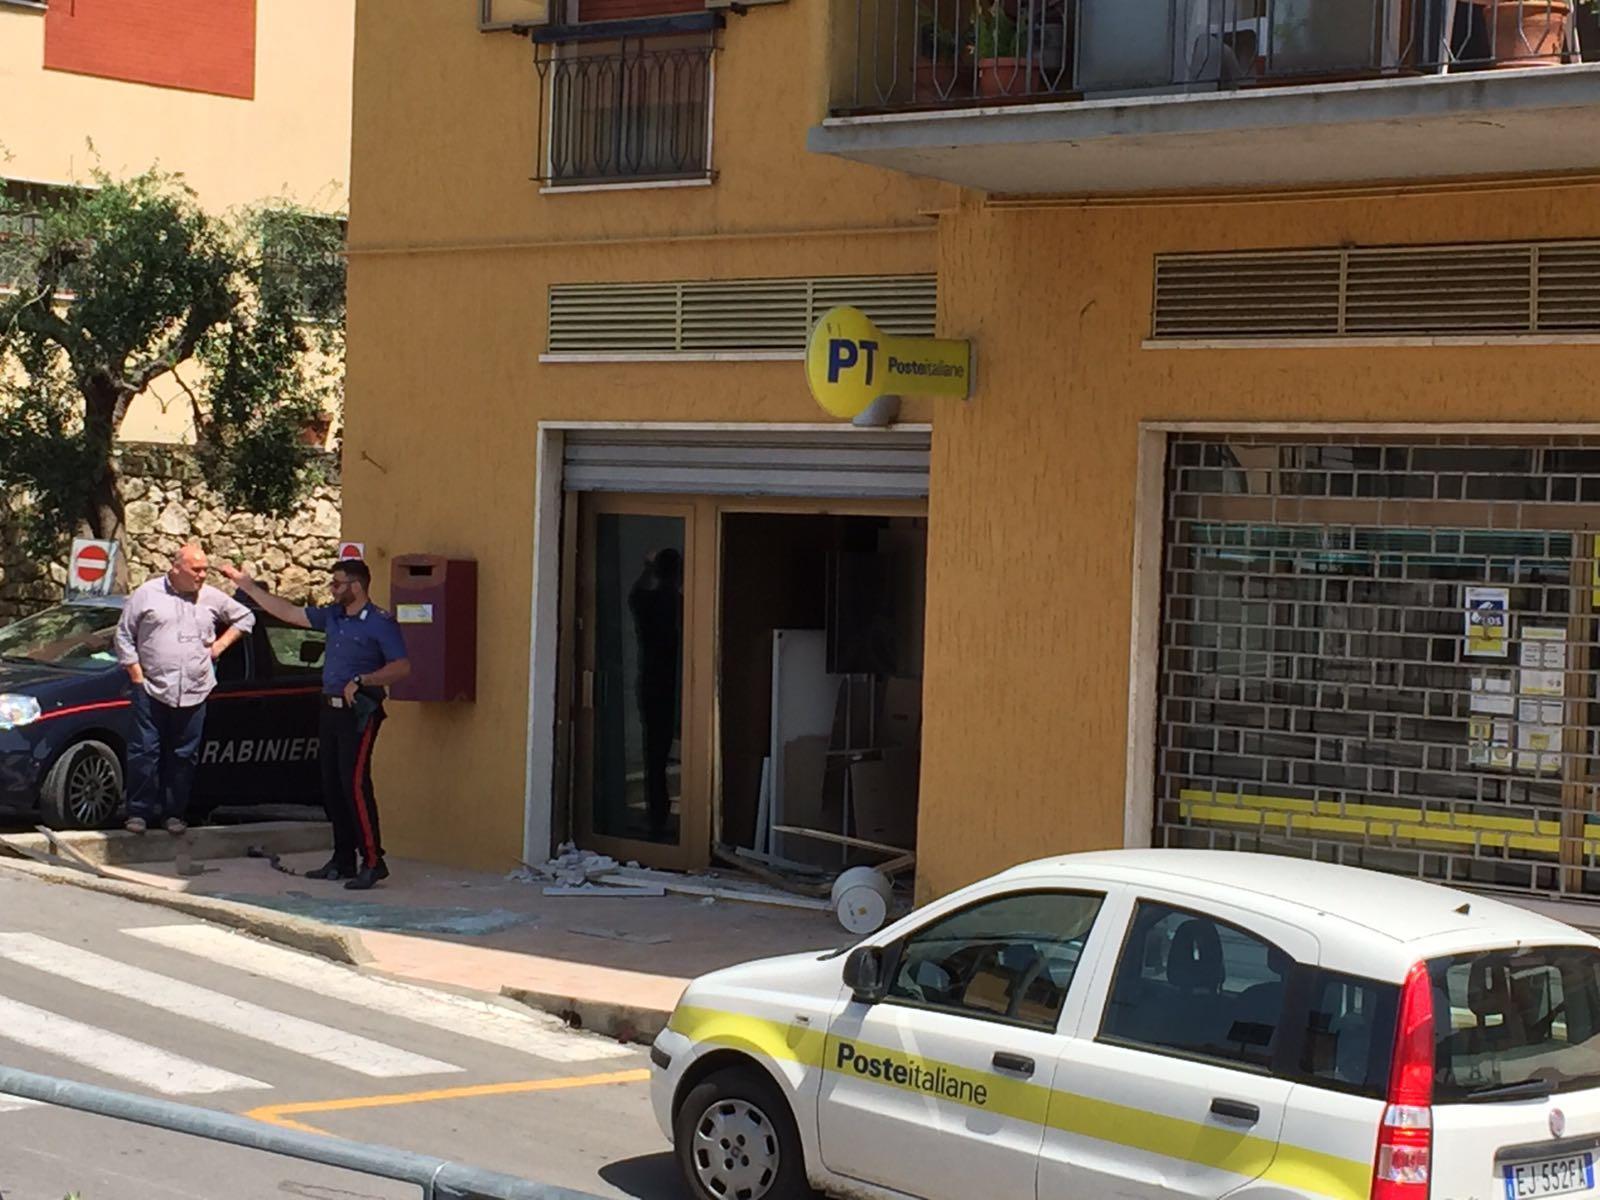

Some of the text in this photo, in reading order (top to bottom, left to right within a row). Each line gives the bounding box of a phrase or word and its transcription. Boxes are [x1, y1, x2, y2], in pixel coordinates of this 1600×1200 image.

[828, 339, 878, 385] PT
[888, 357, 964, 378] Posteitaliane
[200, 738, 320, 764] RABINIER
[837, 1043, 987, 1105] Posteitaliane
